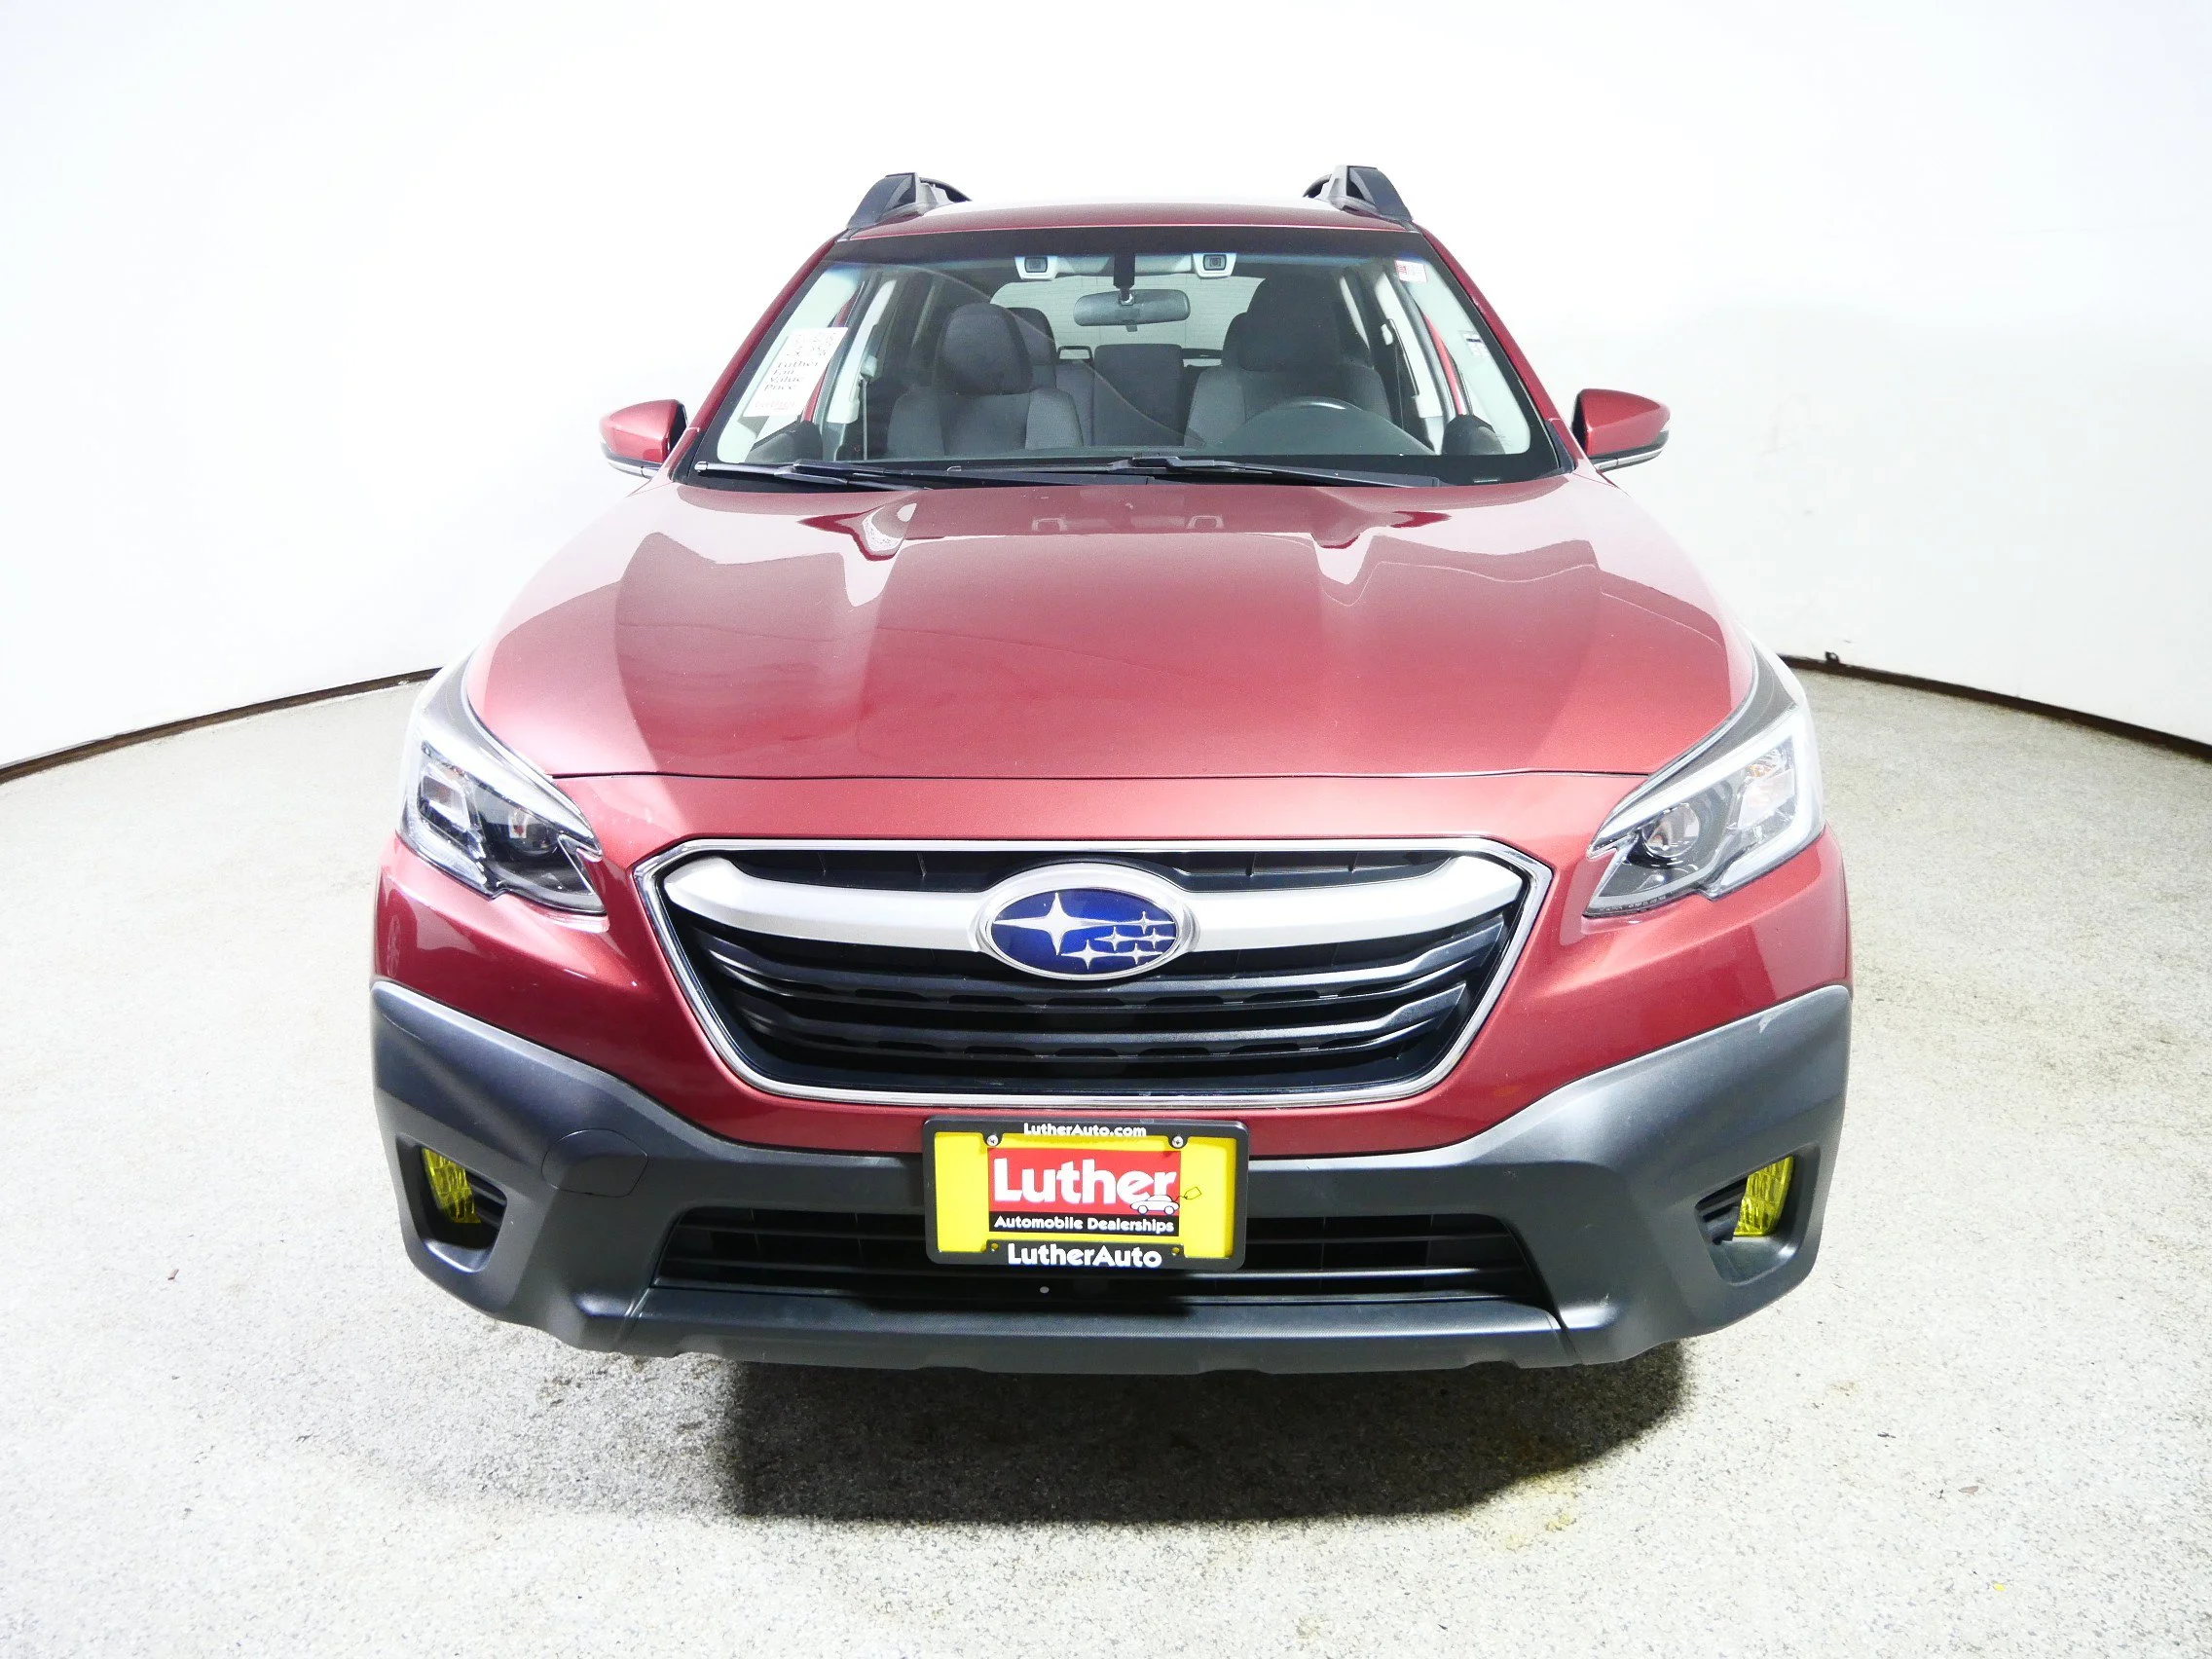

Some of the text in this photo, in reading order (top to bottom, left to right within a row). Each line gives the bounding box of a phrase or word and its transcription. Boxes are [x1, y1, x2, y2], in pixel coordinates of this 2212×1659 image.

[1023, 1123, 1147, 1137] LutherAuto.com
[993, 1158, 1177, 1205] Luther
[993, 1215, 1174, 1234] Automobile Dealerships
[1008, 1242, 1162, 1269] LutherAuto
